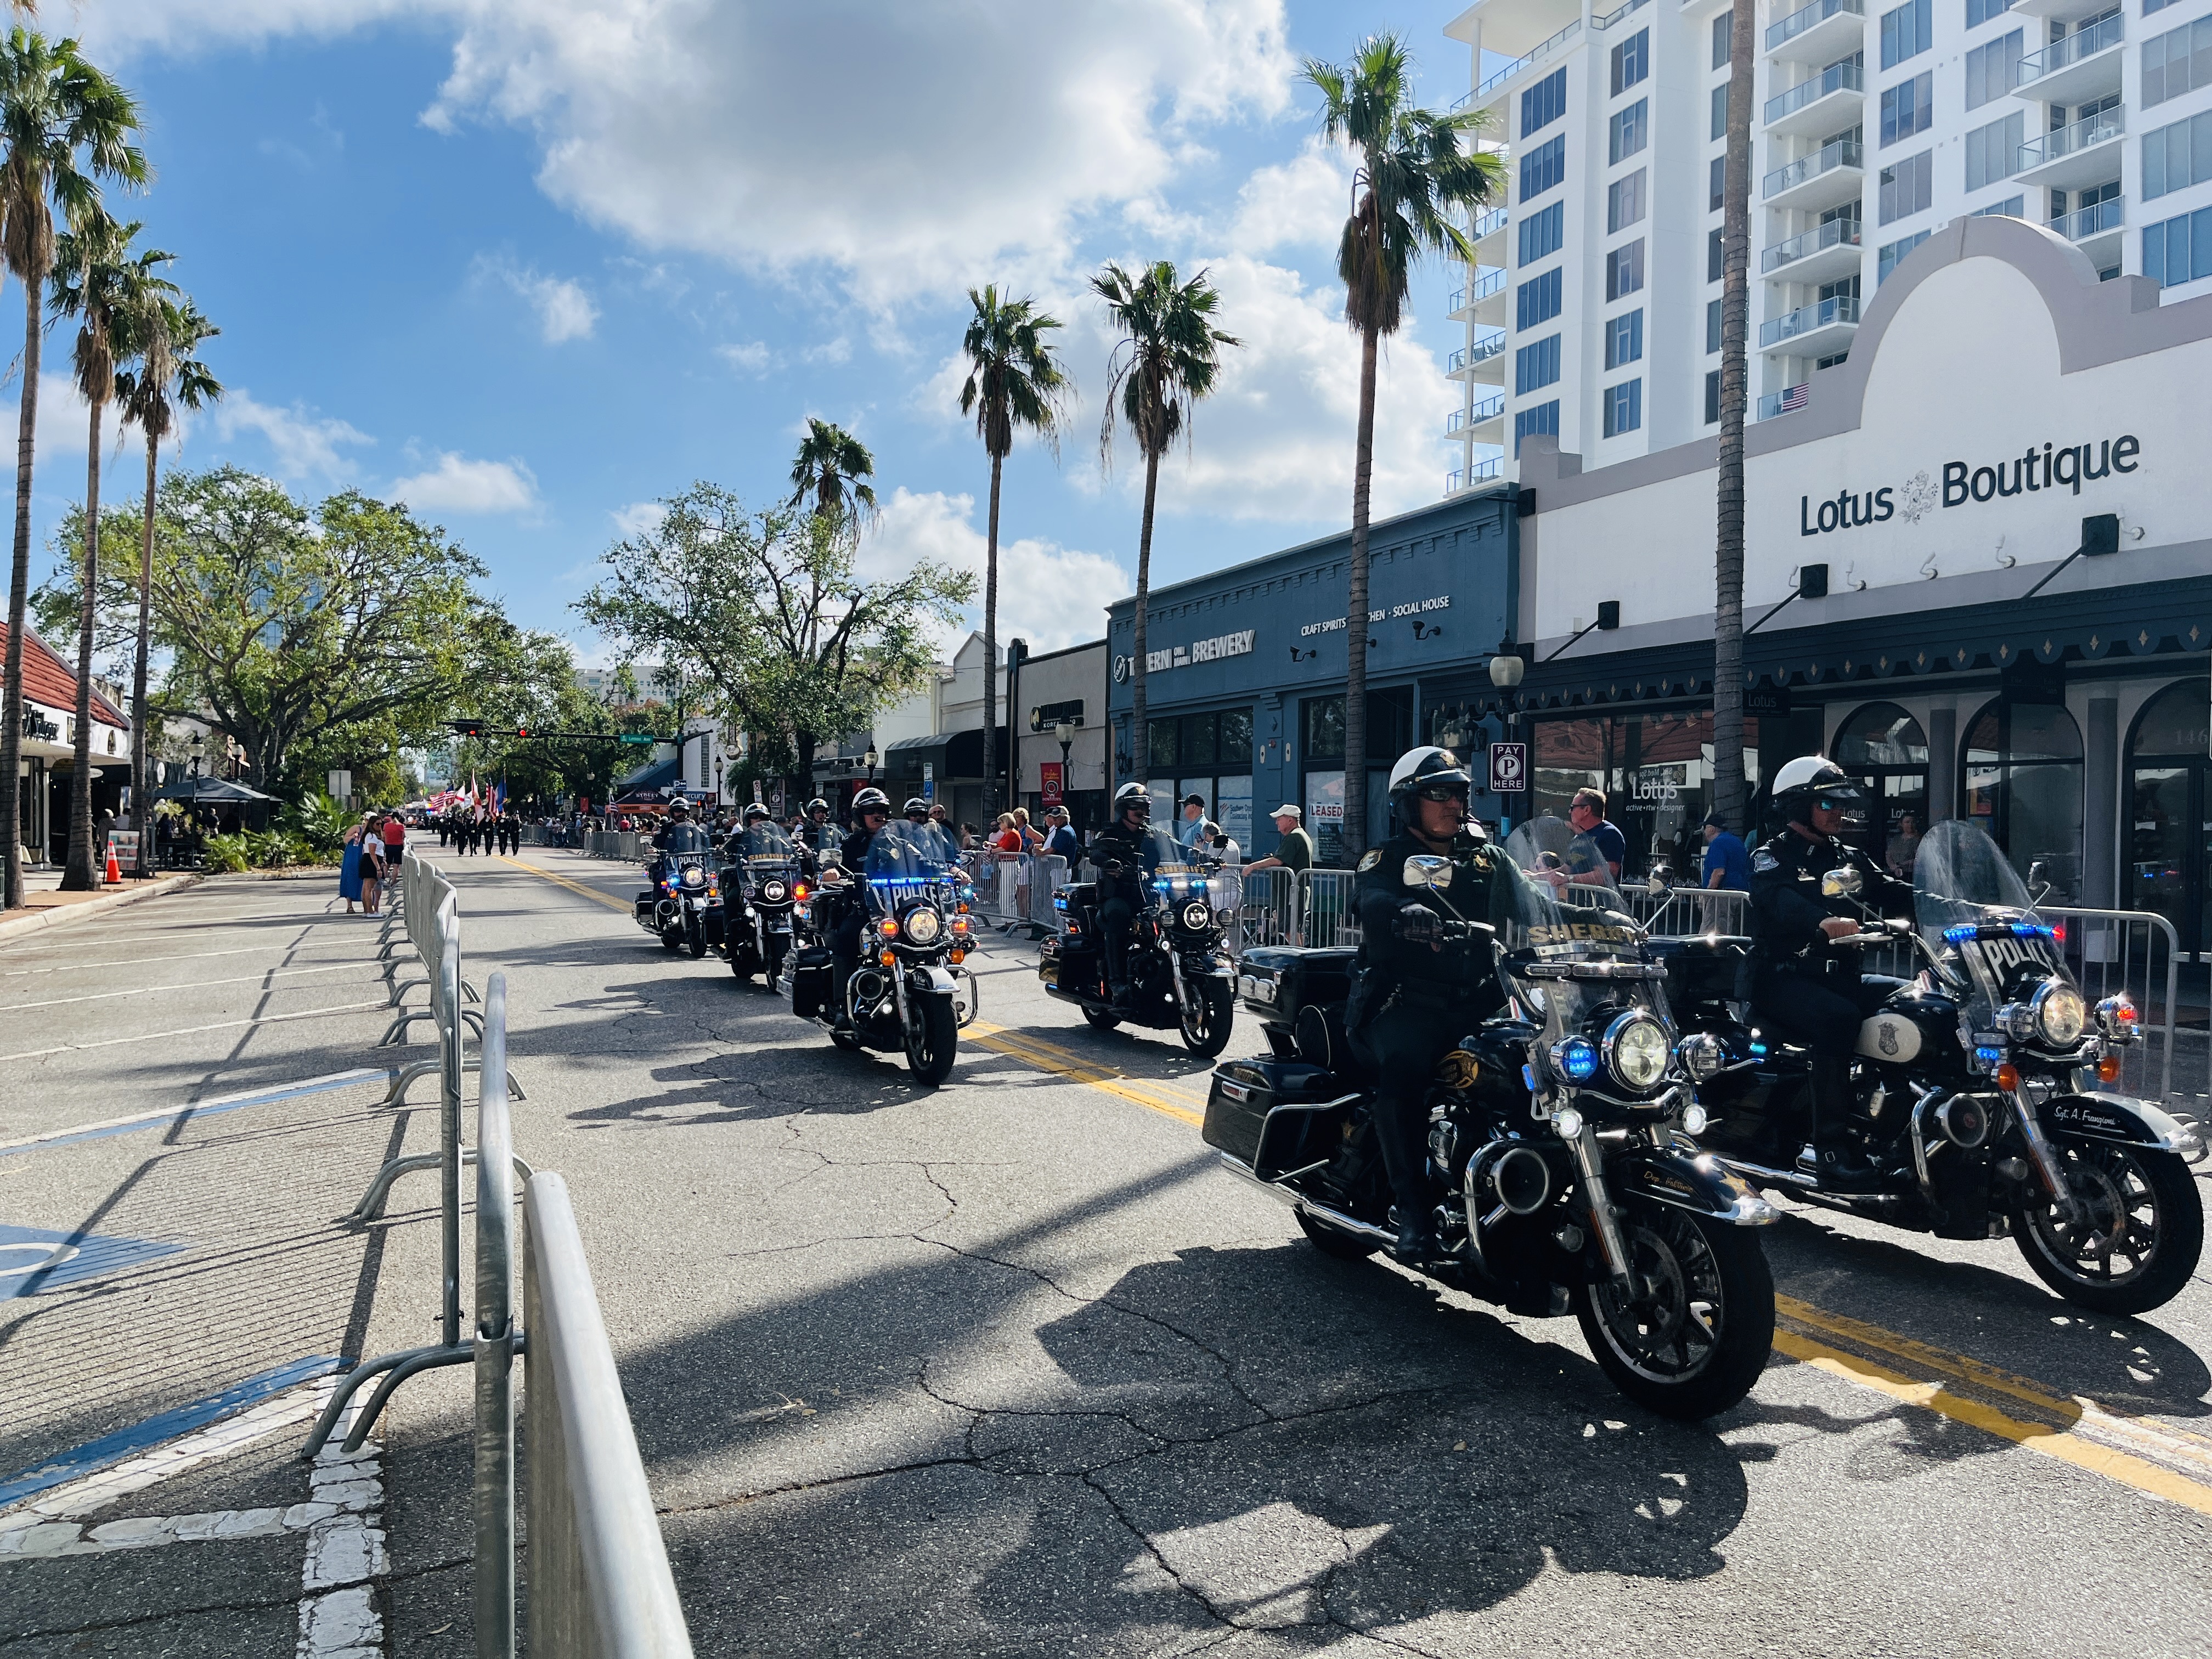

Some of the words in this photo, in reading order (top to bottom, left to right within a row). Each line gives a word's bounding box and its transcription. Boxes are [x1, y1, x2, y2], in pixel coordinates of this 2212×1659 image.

[1801, 486, 1894, 537] Lotus
[1942, 435, 2140, 508] Boutique
[1392, 603, 1420, 618] SOCIAL
[1421, 595, 1449, 612] HOUSE
[1301, 623, 1322, 636] CRAFT
[1322, 617, 1346, 633] SPIRITS
[1127, 648, 1172, 676] TERN
[1192, 629, 1255, 663] BREWERY
[1173, 646, 1185, 656] ON
[1173, 656, 1191, 667] MAIN
[1748, 693, 1777, 707] Lotus
[1497, 746, 1519, 754] PAY
[1503, 759, 1515, 775] P
[1494, 780, 1522, 788] HERE
[1633, 776, 1678, 799] Lotus
[1311, 804, 1343, 817] LEASED
[1659, 803, 1685, 813] designer
[1843, 808, 1865, 819] Lotus
[1891, 808, 1915, 819] Lot
[678, 855, 703, 870] POLICE
[1154, 866, 1207, 874] SHERIFF
[891, 884, 939, 911] POLICE
[2070, 1108, 2081, 1120] A.
